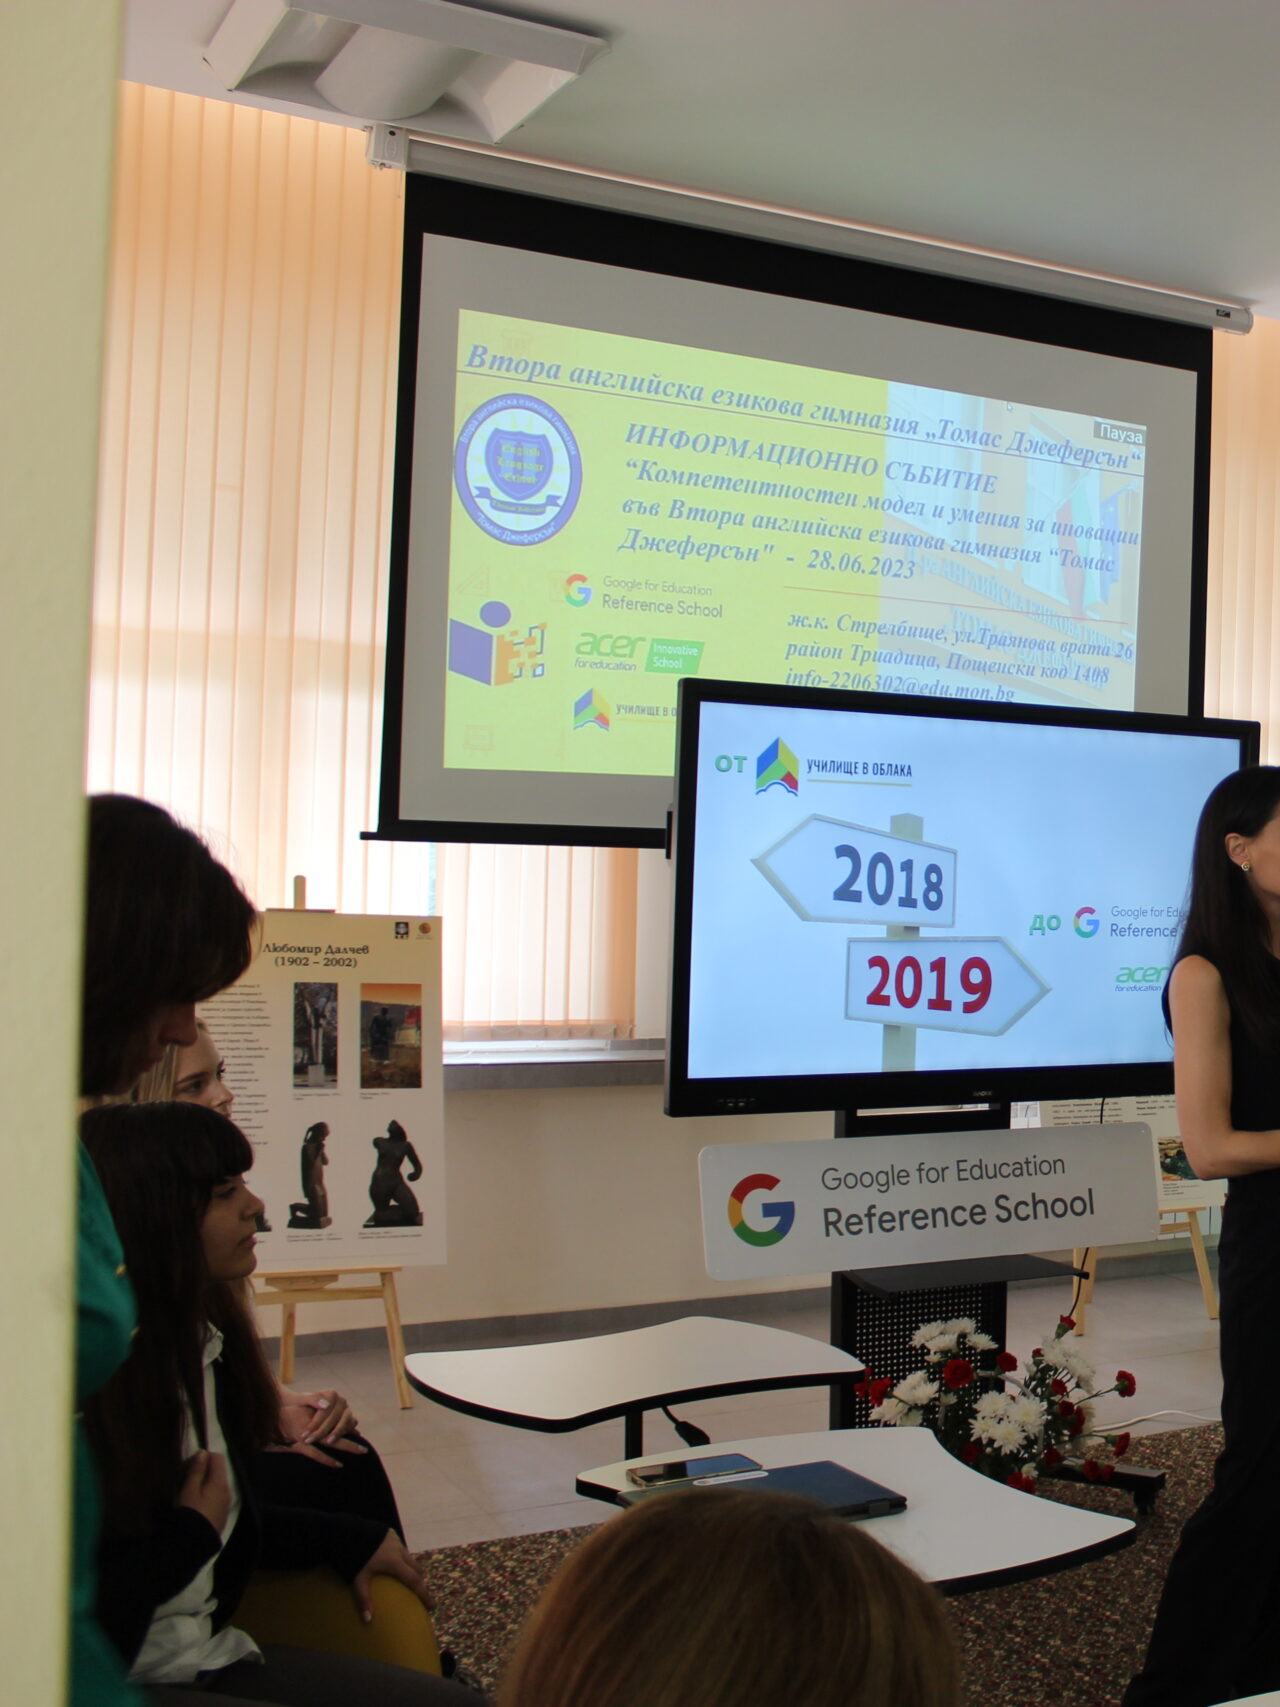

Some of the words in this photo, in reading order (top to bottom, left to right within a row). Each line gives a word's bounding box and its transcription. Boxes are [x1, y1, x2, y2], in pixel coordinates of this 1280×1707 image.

[465, 344, 561, 382] Втора
[568, 367, 704, 402] английска
[711, 389, 805, 418] езикова
[810, 403, 920, 436] гимназия
[1099, 424, 1144, 445] Пауза
[624, 422, 878, 477] ИНФОРМАЦИОННО
[884, 460, 998, 495] СЪБИТИЕ
[621, 498, 660, 517] във
[668, 498, 746, 530] Втора
[751, 511, 863, 541] английска
[868, 528, 945, 551] езикова
[950, 539, 1042, 564] гимназия
[863, 493, 926, 519] модел
[932, 503, 944, 519] и
[947, 506, 1020, 531] умения
[1026, 516, 1045, 533] за
[1050, 519, 1140, 546] иновации
[806, 549, 917, 581] 28.06.2023
[603, 575, 642, 592] Google
[645, 579, 659, 591] for
[661, 581, 712, 597] Education
[602, 594, 674, 614] Reference
[677, 600, 723, 618] School
[575, 632, 647, 659] acer
[653, 644, 699, 656] Innovative
[787, 613, 829, 630] ж.к.
[836, 613, 948, 645] Стрелбище,
[1060, 642, 1111, 659] врата
[1113, 642, 1133, 660] 26
[653, 656, 683, 669] School
[784, 643, 843, 661] район
[850, 643, 940, 671] Триадица,
[945, 653, 1036, 679] Пощенски
[1040, 664, 1068, 681] код
[1073, 665, 1110, 684] 1408
[784, 668, 1015, 702] info-2206302@edu.mon.bg
[616, 704, 660, 717] УЧИЛИЩЕ
[807, 759, 859, 775] УЧИЛИЩЕ
[862, 763, 869, 775] В
[872, 763, 912, 778] ОБЛАКА
[833, 844, 944, 912] 2018
[1111, 905, 1148, 920] Google
[1150, 906, 1165, 918] for
[1110, 923, 1177, 938] Reference
[263, 942, 322, 956] Любомир
[324, 944, 370, 955] Далчев
[274, 956, 310, 967] (1902
[323, 957, 357, 968] 2002)
[866, 955, 992, 1014] 2019
[1115, 966, 1169, 983] acer
[821, 1164, 910, 1194] Google
[916, 1162, 949, 1185] for
[956, 1155, 1066, 1182] Education
[823, 1202, 988, 1238] Reference
[994, 1187, 1095, 1224] School
